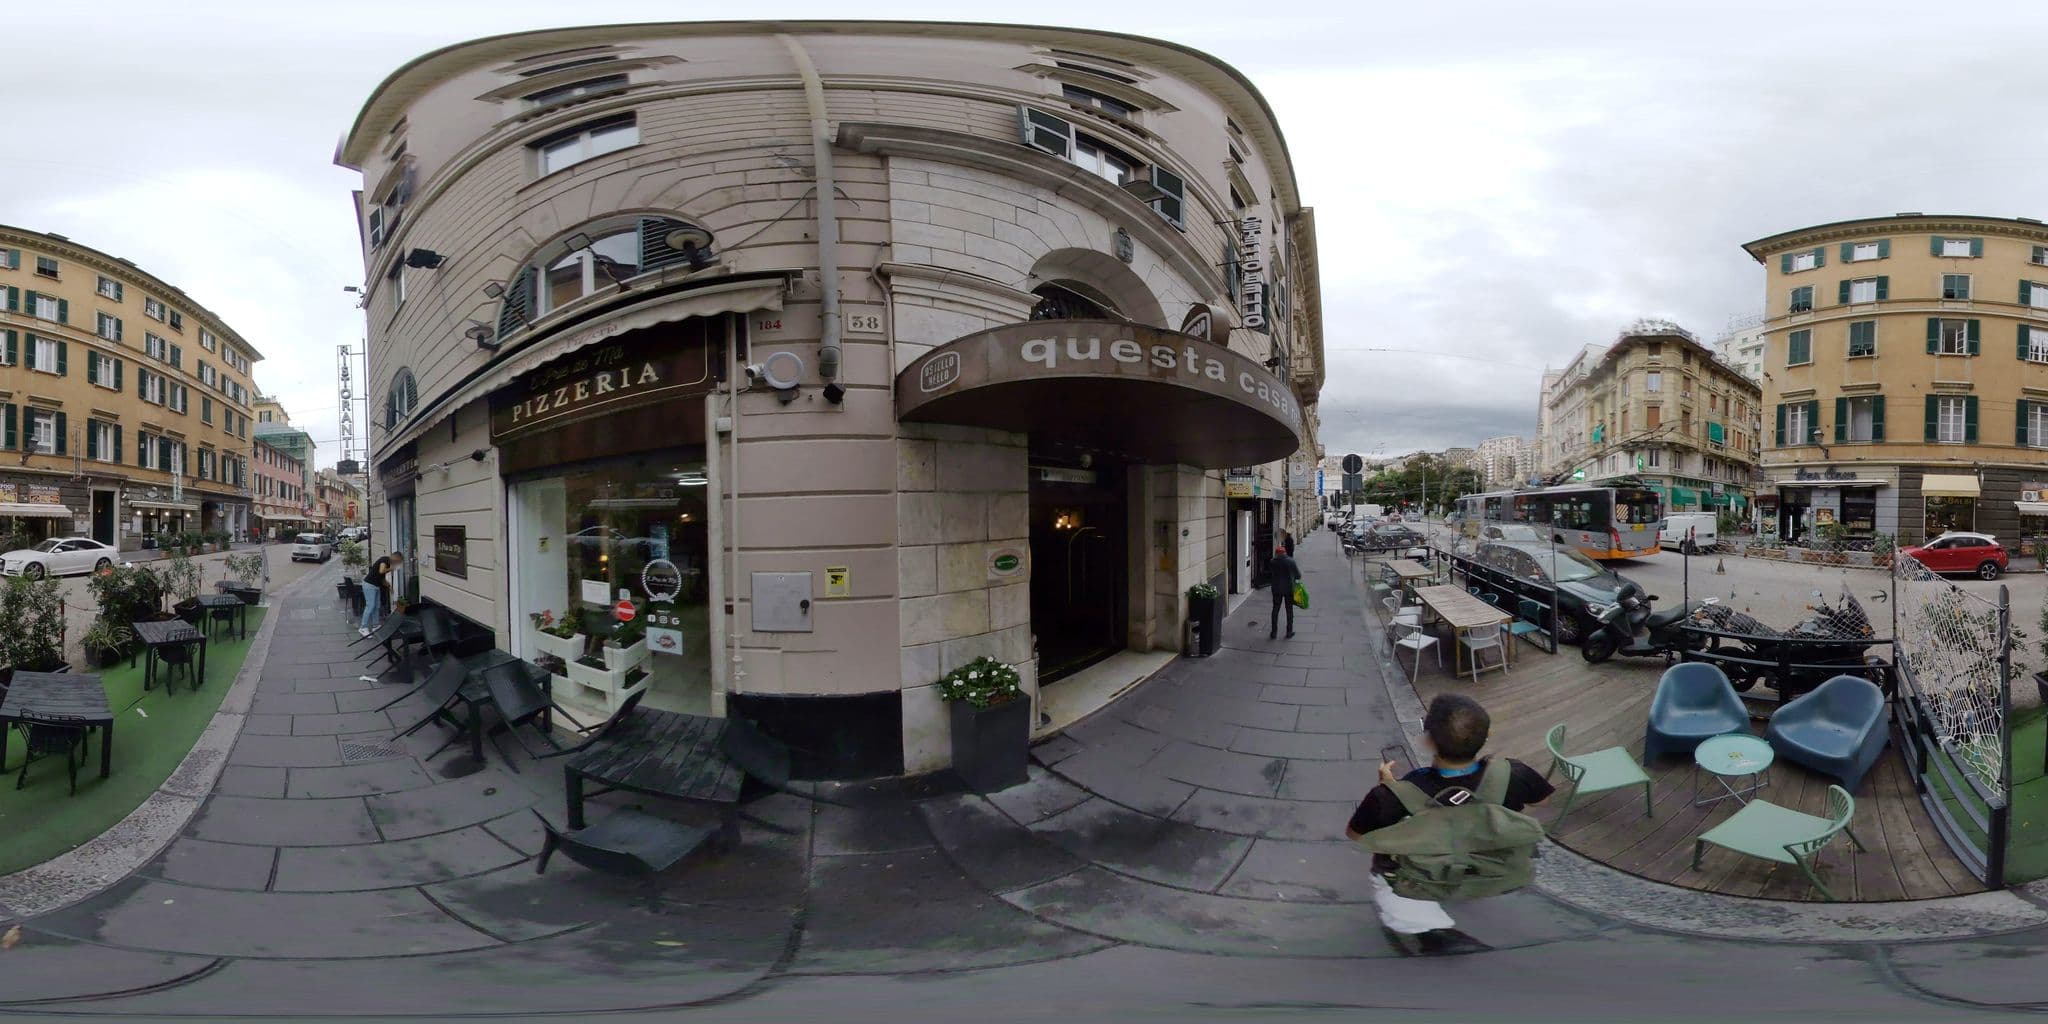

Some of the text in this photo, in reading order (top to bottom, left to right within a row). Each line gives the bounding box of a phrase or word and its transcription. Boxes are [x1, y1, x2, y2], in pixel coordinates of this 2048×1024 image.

[759, 319, 783, 330] 184
[851, 315, 879, 329] 38
[340, 344, 353, 461] RISTORANTE
[512, 361, 660, 423] PIZZERIA
[1020, 336, 1288, 415] questa casa
